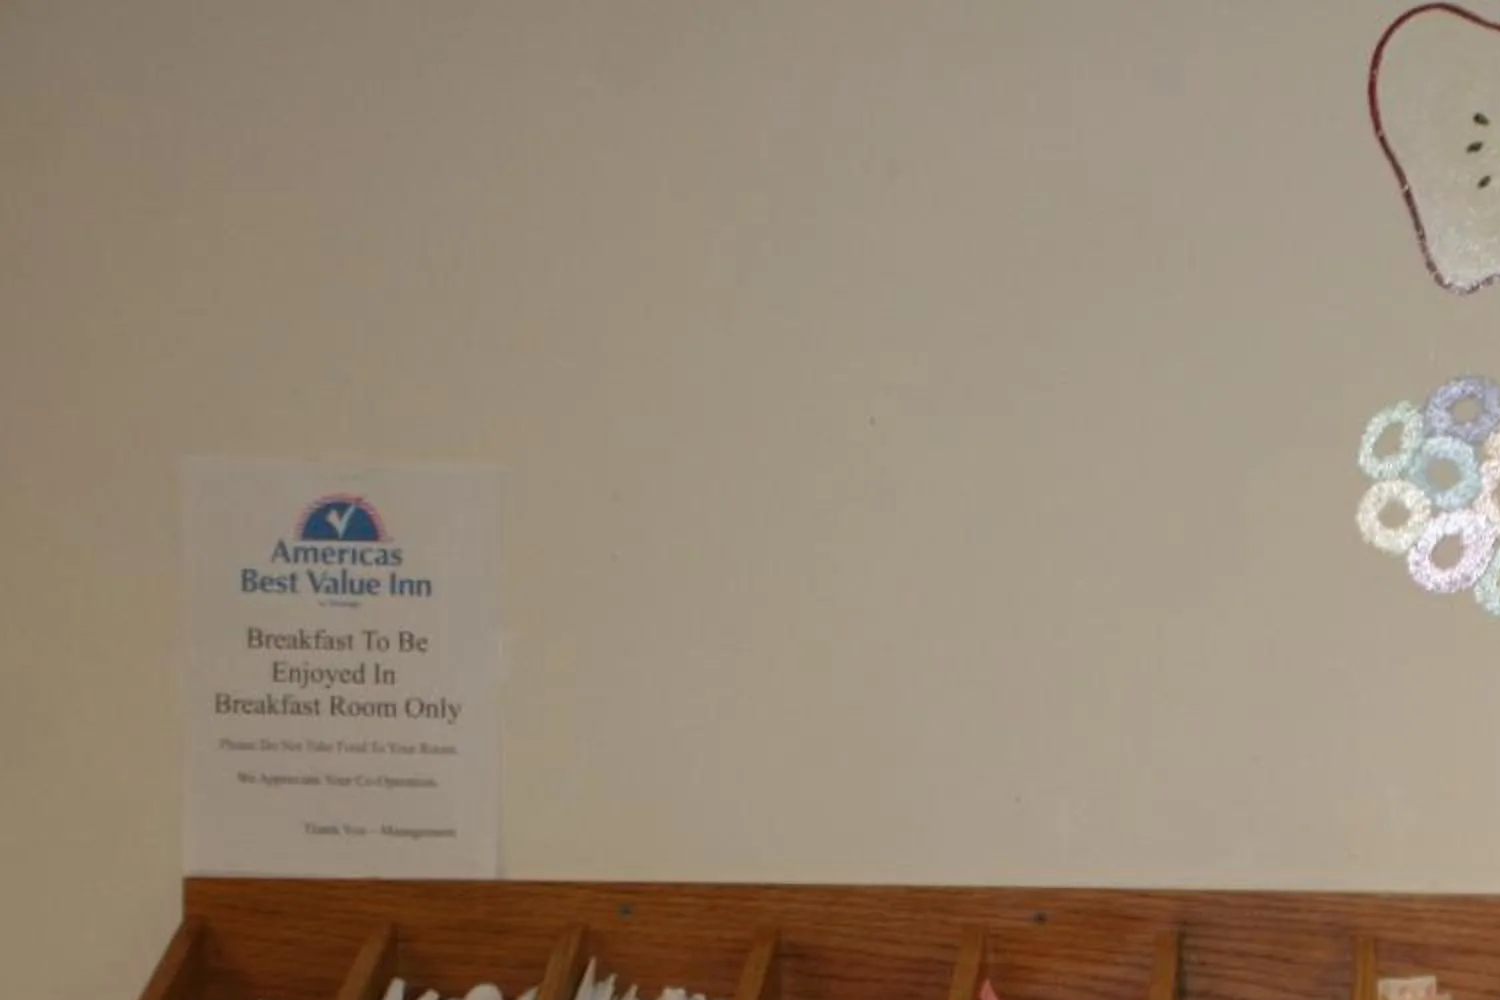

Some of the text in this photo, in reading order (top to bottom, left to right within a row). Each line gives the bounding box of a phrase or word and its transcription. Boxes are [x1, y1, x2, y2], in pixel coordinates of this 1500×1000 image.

[271, 540, 403, 566] Americas
[240, 568, 432, 597] Best Value Inn
[247, 627, 428, 653] Breakfast To Be
[272, 661, 396, 688] Enjoyed In
[214, 692, 462, 724] Breakfast Room Only
